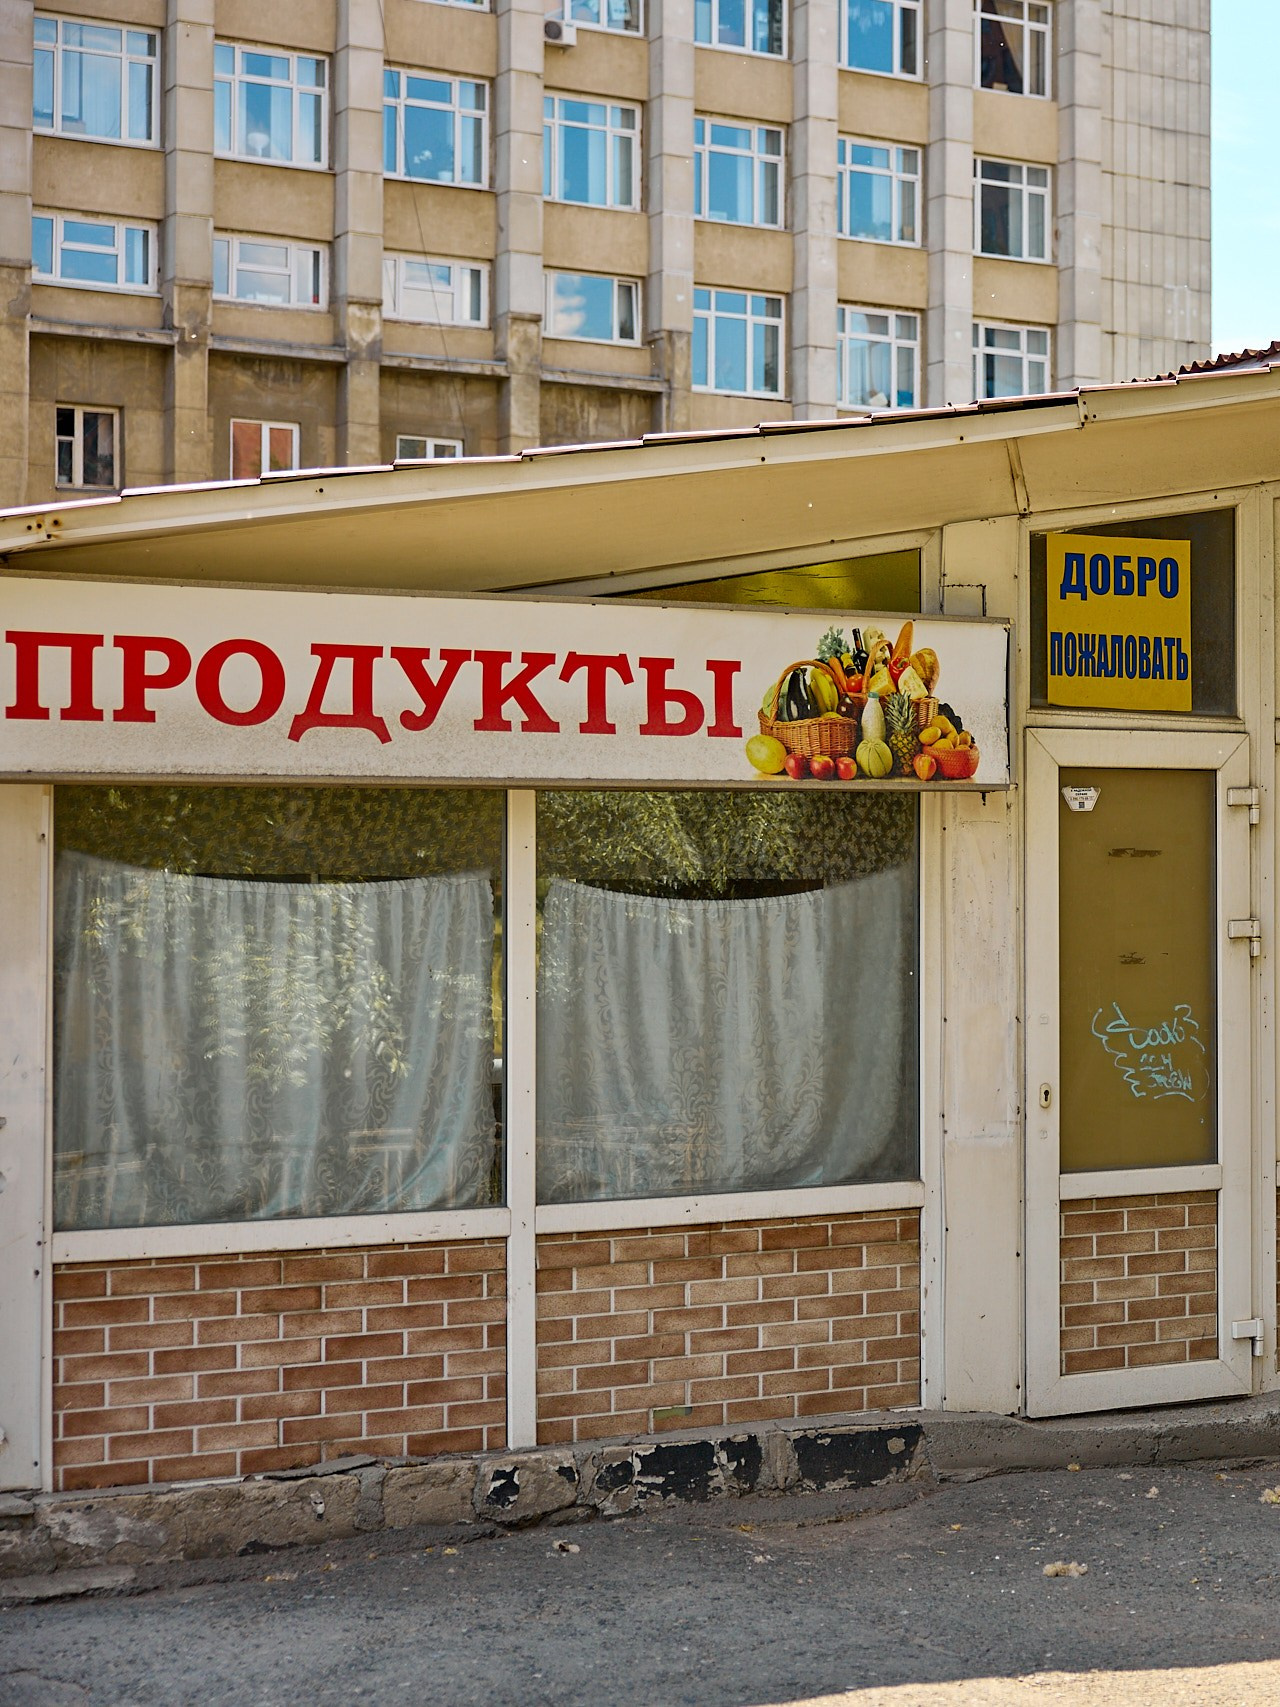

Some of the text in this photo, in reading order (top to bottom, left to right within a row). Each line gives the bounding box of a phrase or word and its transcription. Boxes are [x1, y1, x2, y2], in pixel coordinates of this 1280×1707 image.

[1060, 552, 1179, 601] ДОБРО
[1050, 631, 1188, 681] ПОЖАЛОВАТЬ
[5, 630, 744, 744] ПРОДУКТЫ
